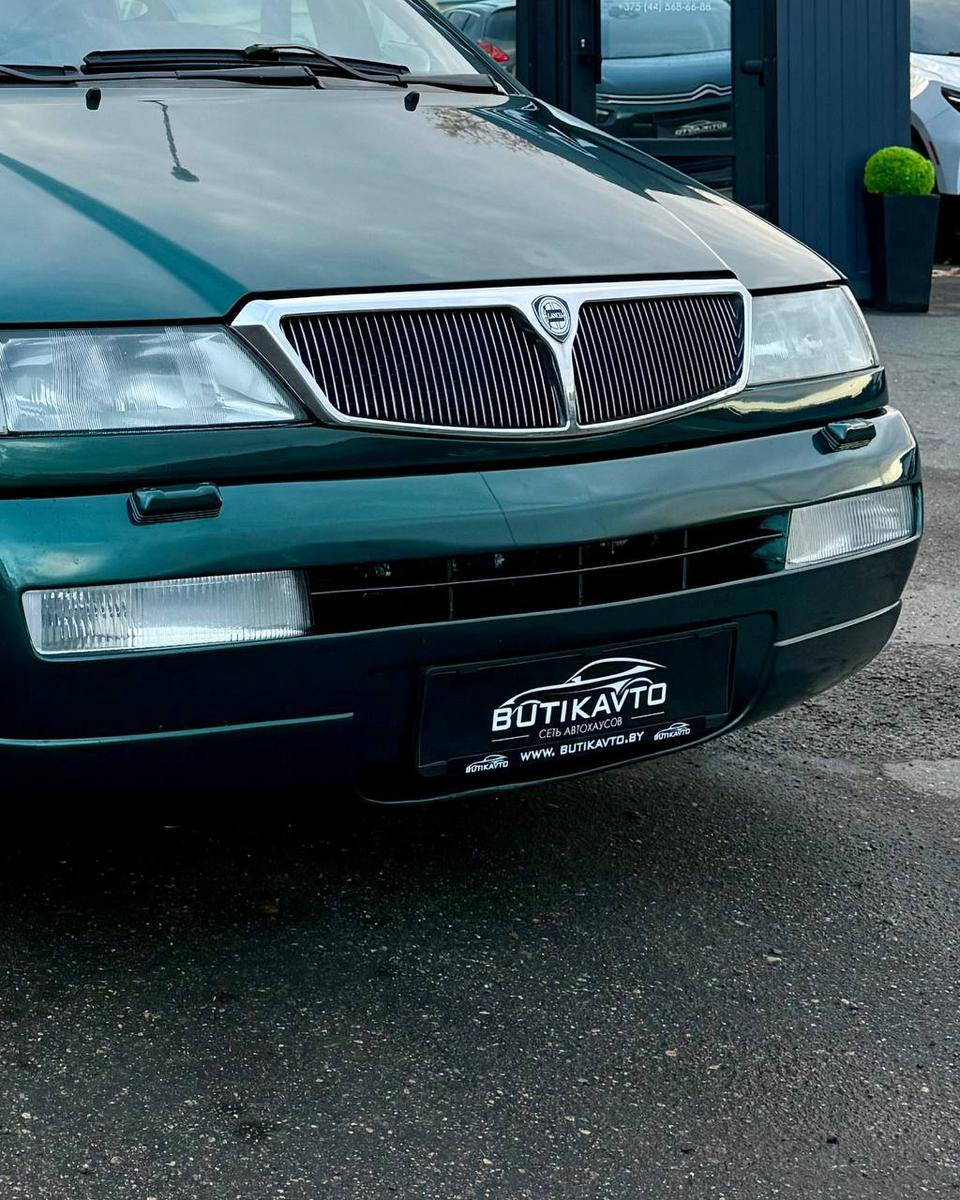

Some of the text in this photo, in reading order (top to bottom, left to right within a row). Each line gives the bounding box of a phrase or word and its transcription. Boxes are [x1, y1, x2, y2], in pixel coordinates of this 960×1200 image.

[491, 682, 667, 732] BUTIKAVTO
[538, 716, 623, 740] СЕТЬ АВТОХАУСОВ
[653, 727, 691, 742] BUTIKAVTO
[520, 731, 645, 762] WWW. BUTIKAVTO.BY
[465, 761, 509, 774] BUTIKAVTO
